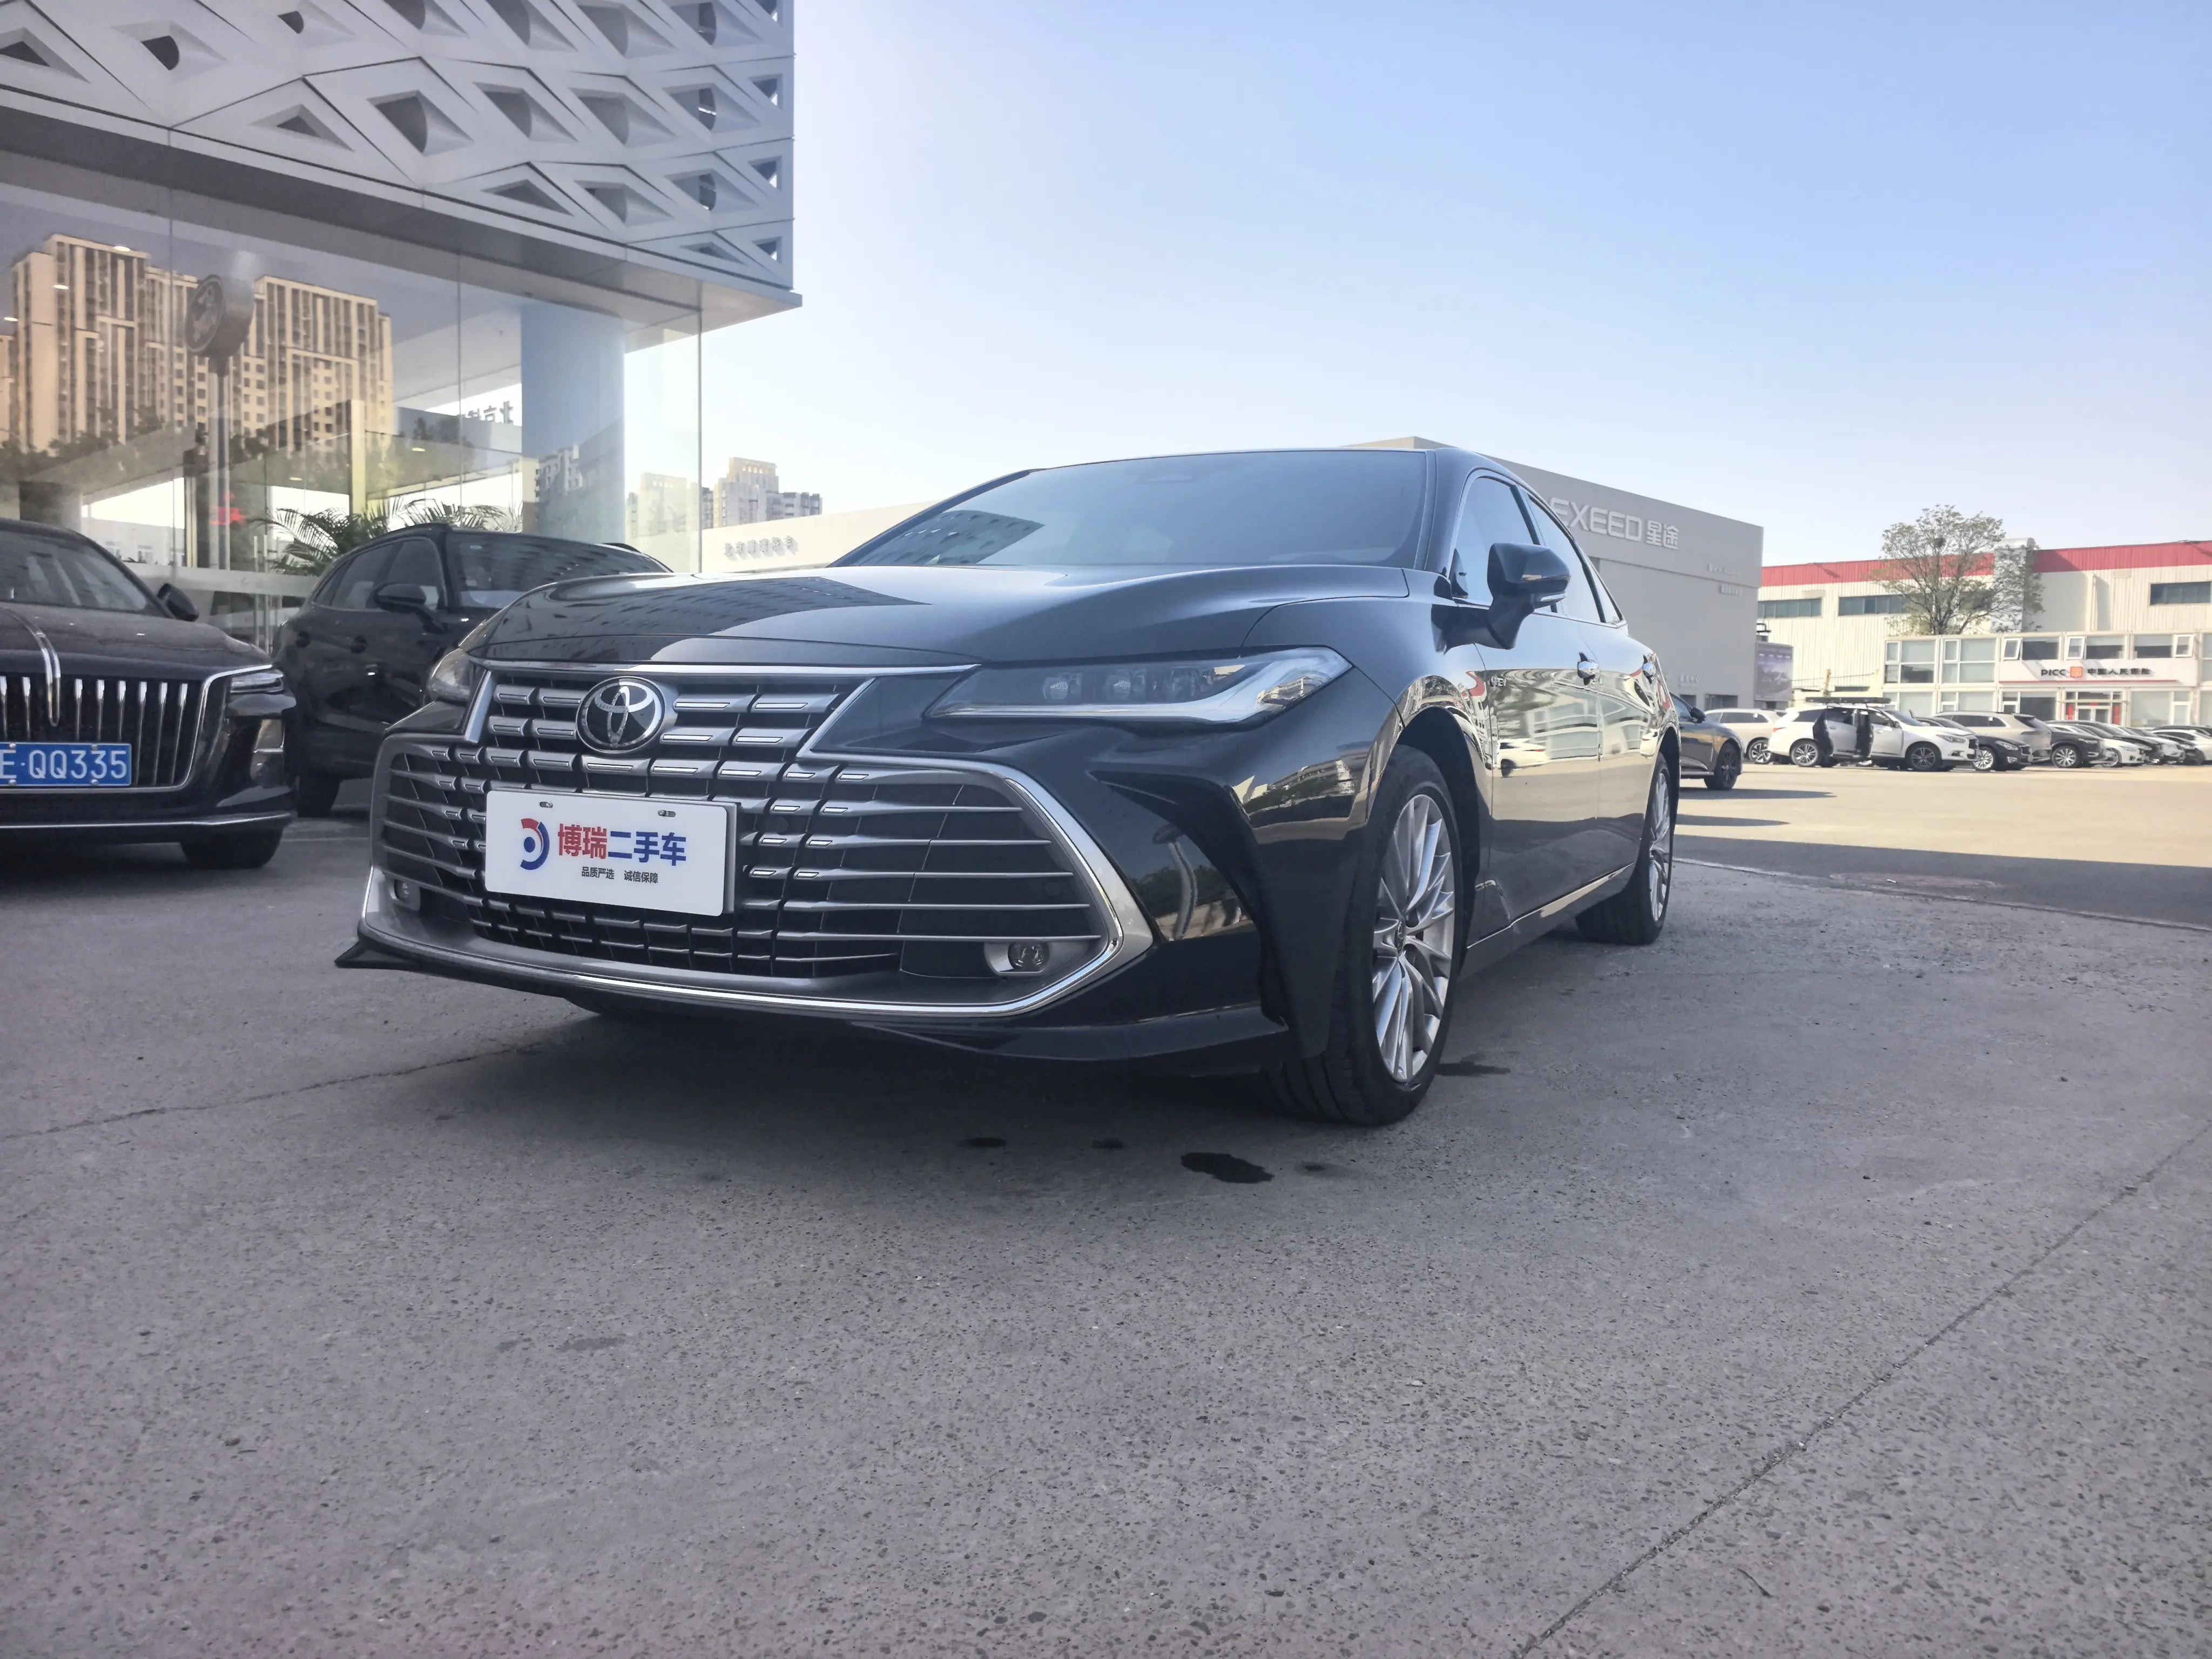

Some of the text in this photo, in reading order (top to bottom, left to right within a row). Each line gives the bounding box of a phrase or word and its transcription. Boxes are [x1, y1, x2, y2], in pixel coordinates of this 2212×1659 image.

[1550, 497, 1680, 550] EXEED 星途
[558, 823, 686, 866] 博瑞二手车
[581, 866, 658, 884] 品质严选 诚信保障
